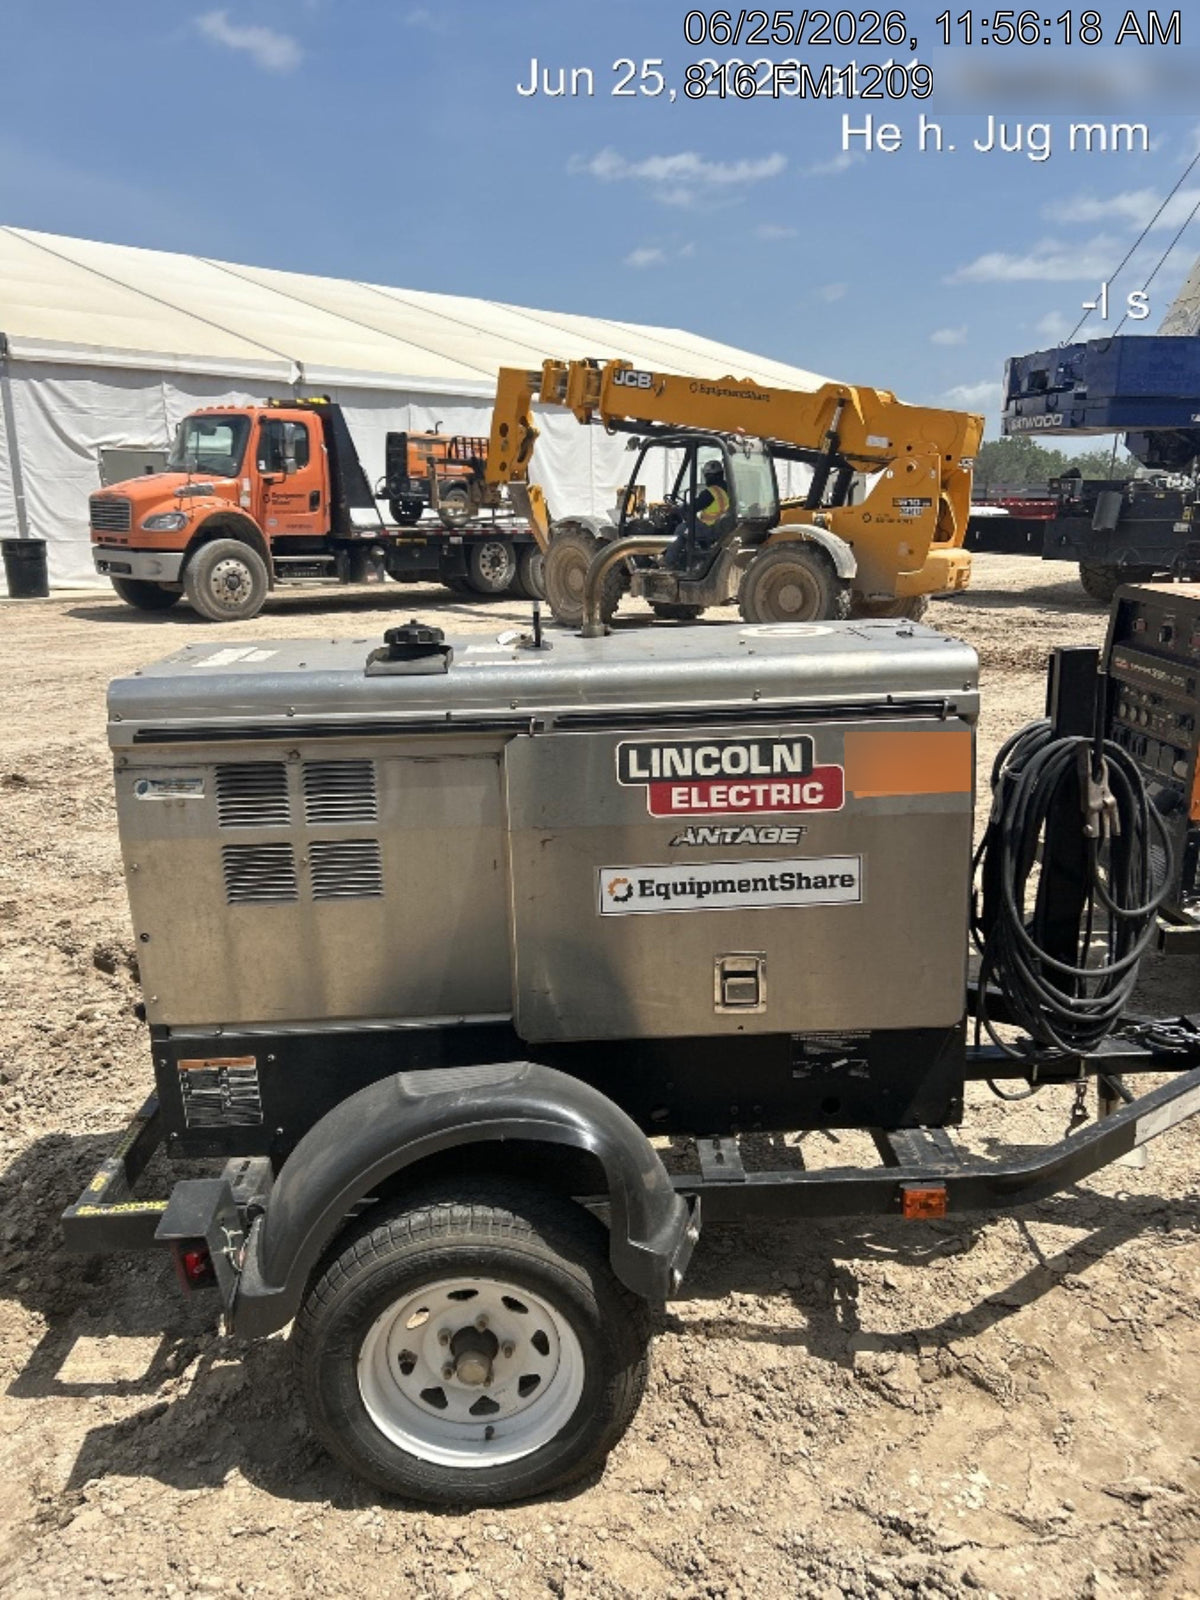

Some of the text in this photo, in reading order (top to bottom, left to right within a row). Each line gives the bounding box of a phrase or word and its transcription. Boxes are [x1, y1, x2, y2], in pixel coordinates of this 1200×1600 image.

[613, 370, 652, 389] JCB
[627, 742, 803, 779] LINCOLN
[670, 782, 825, 809] ELECTRIC
[637, 871, 856, 901] EquipmentShare
